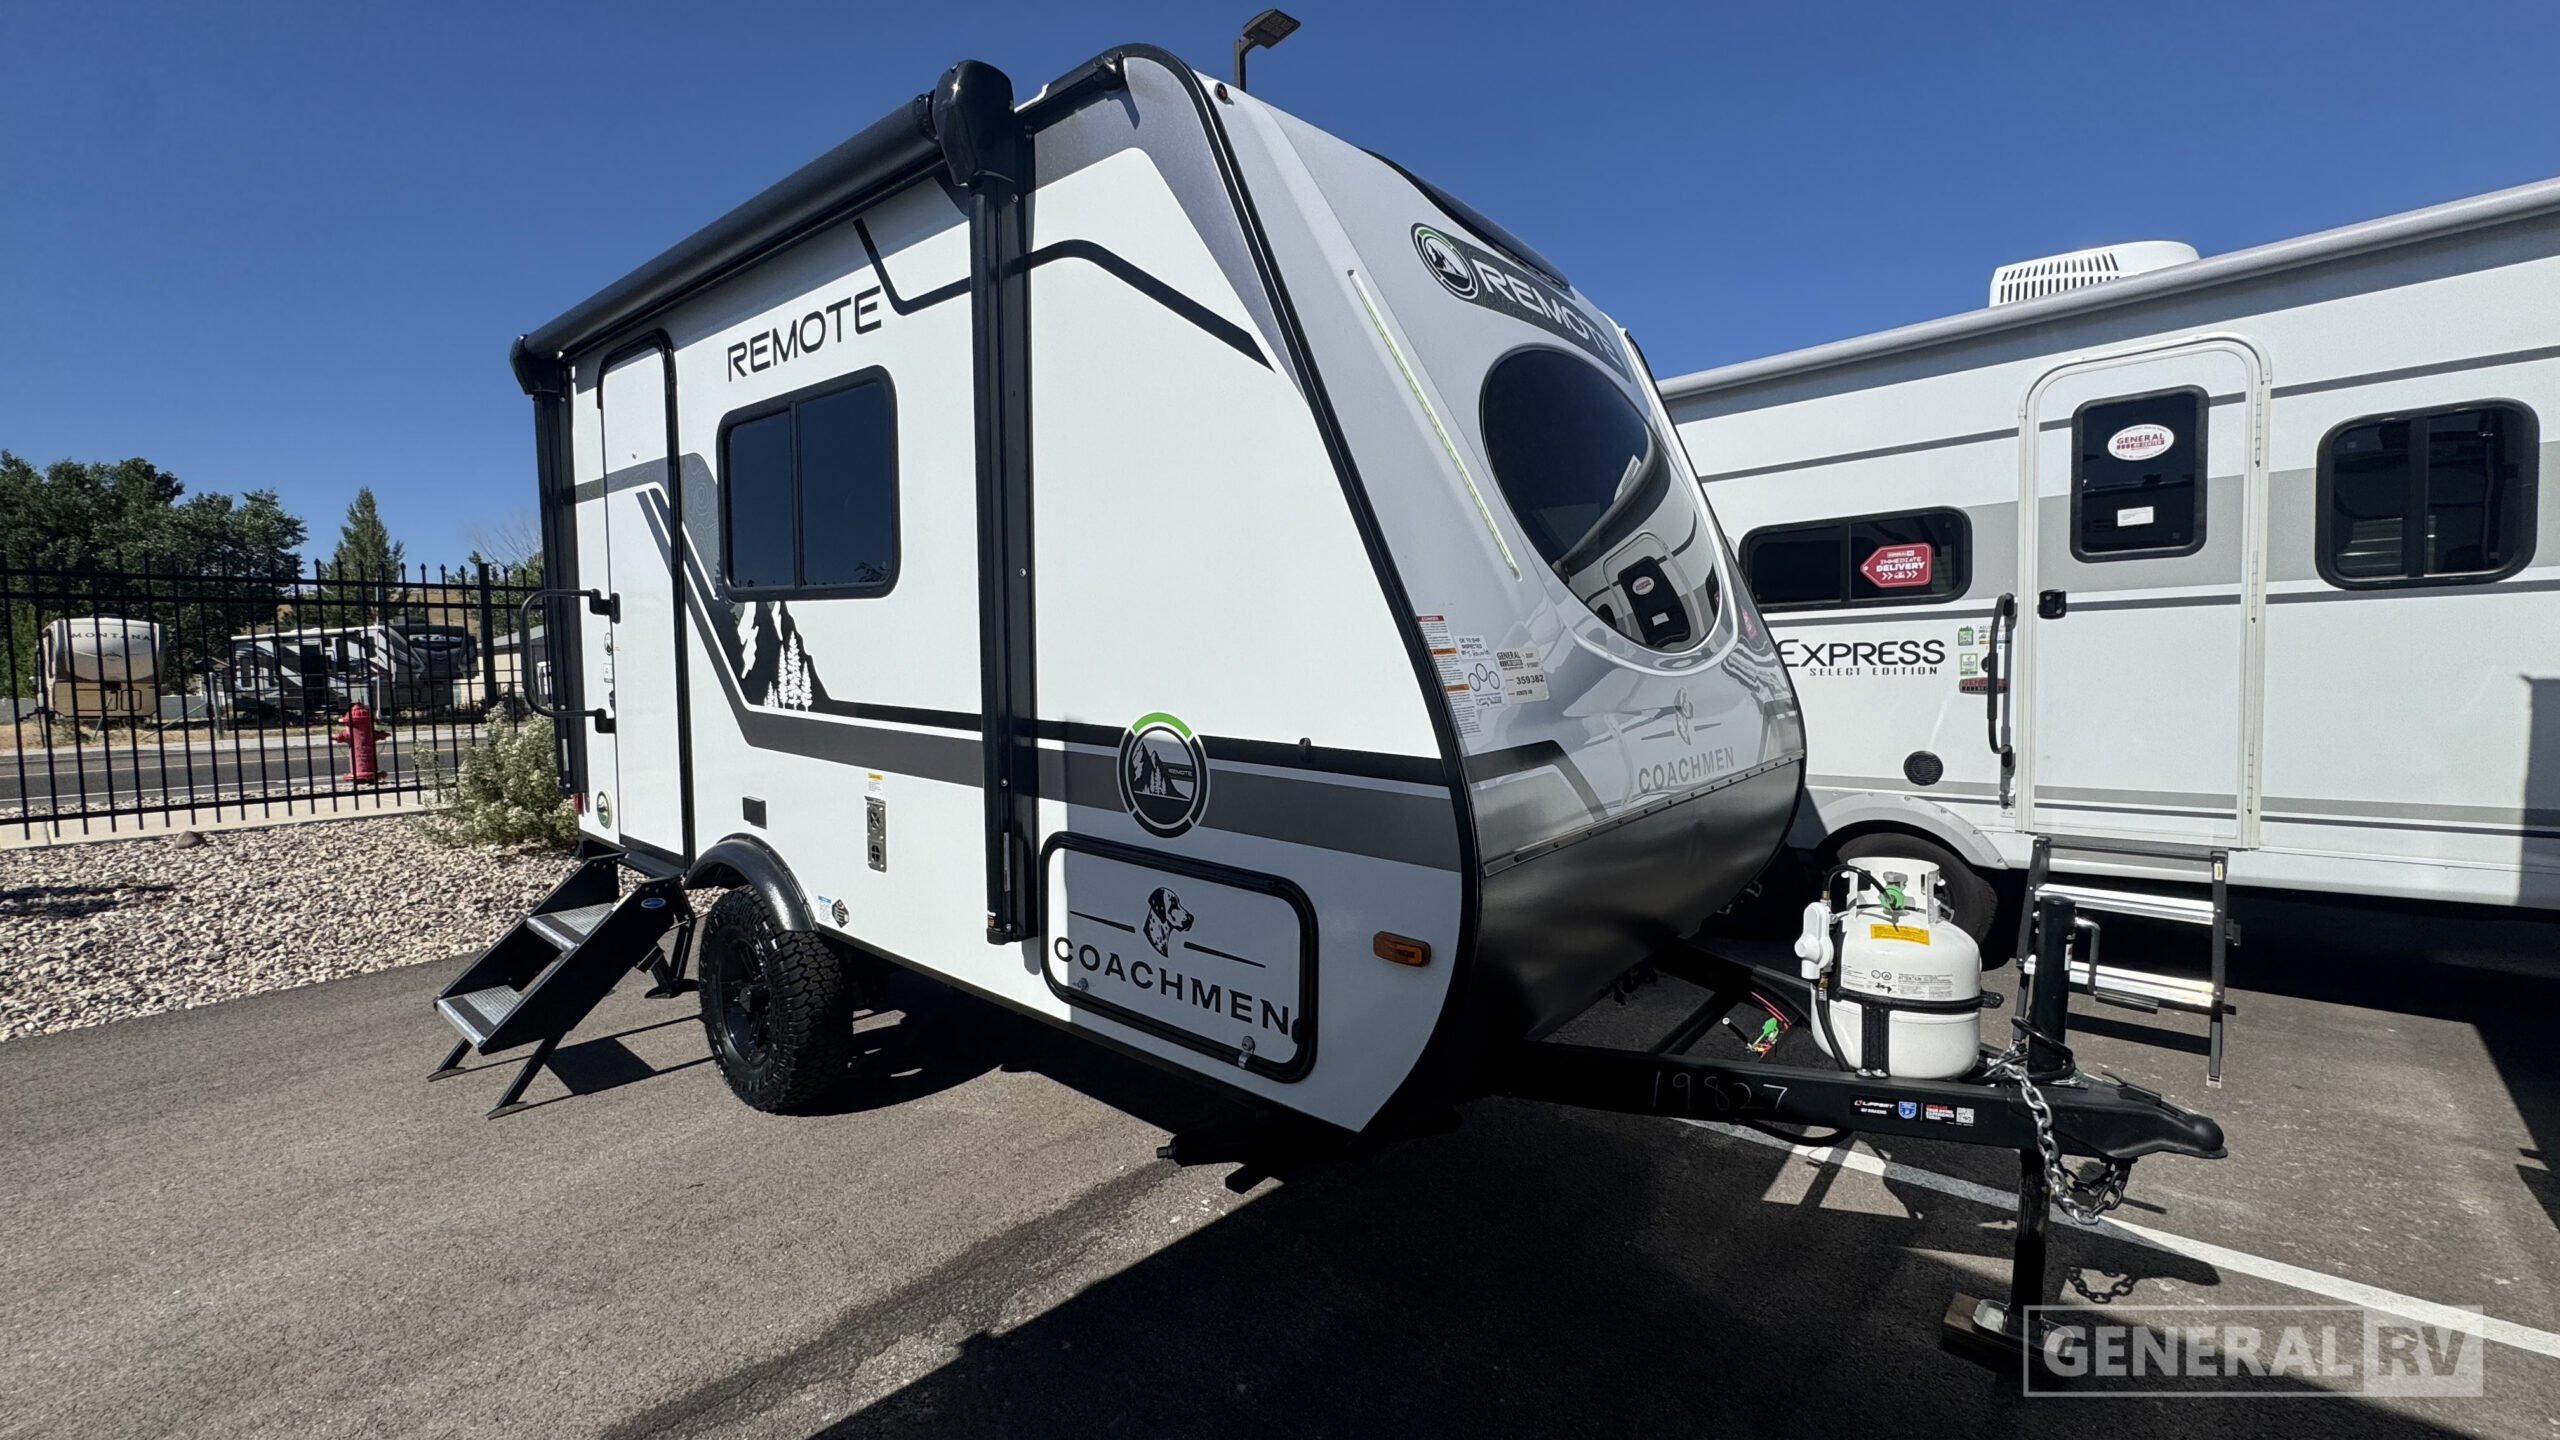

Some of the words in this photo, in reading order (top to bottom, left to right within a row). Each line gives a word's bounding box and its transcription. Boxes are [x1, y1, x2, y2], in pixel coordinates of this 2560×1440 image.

[1471, 257, 1624, 369] REMOTE
[727, 285, 882, 382] REMOTE
[2116, 433, 2165, 444] GENERAL
[1880, 556, 1922, 565] IMMEDIATE
[1876, 561, 1925, 572] DELIVERY
[71, 632, 151, 641] MONTNA
[1496, 651, 1521, 661] GENERAL
[1777, 638, 1946, 668] EXPRESS
[1810, 667, 1861, 677] SELECT
[1872, 666, 1938, 676] EDITION
[1516, 675, 1544, 685] 359382
[1168, 768, 1193, 777] REMOTE
[1638, 746, 1734, 793] COACHMEN
[1053, 936, 1290, 1036] COACHMEN
[1652, 1071, 1788, 1111] 19827
